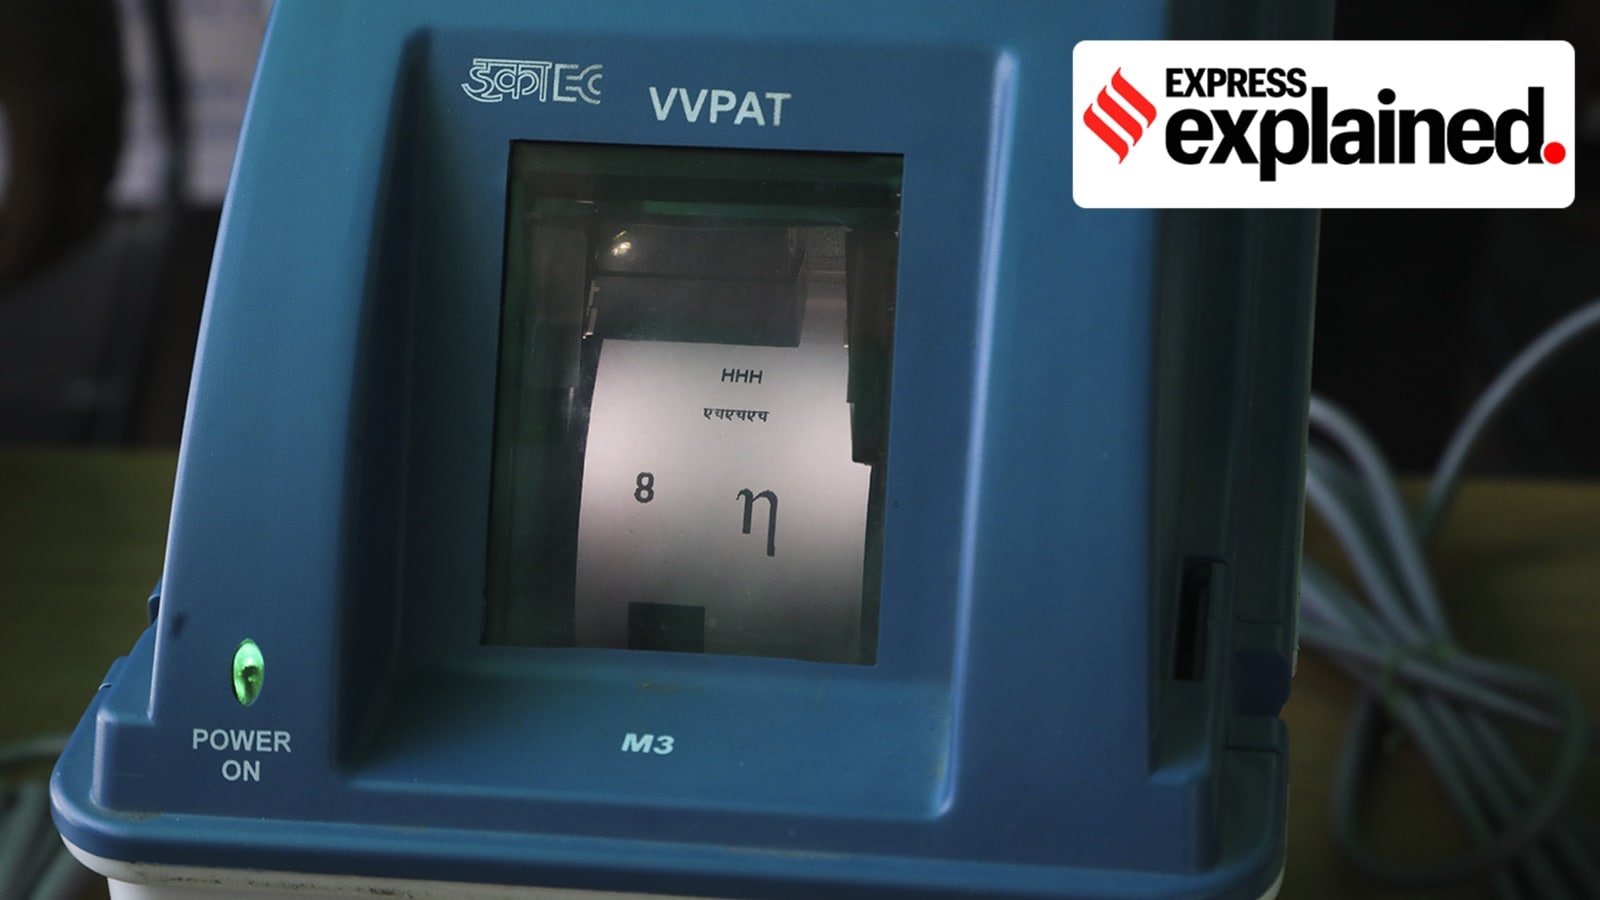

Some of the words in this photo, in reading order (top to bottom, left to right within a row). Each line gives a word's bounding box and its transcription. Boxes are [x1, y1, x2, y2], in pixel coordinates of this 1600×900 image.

[649, 86, 792, 127] VVPAT
[721, 367, 763, 385] HHH
[703, 407, 770, 423] एचएचएच
[633, 471, 655, 504] 8
[192, 728, 292, 754] POWER
[621, 733, 676, 756] M3
[221, 759, 261, 783] ON
